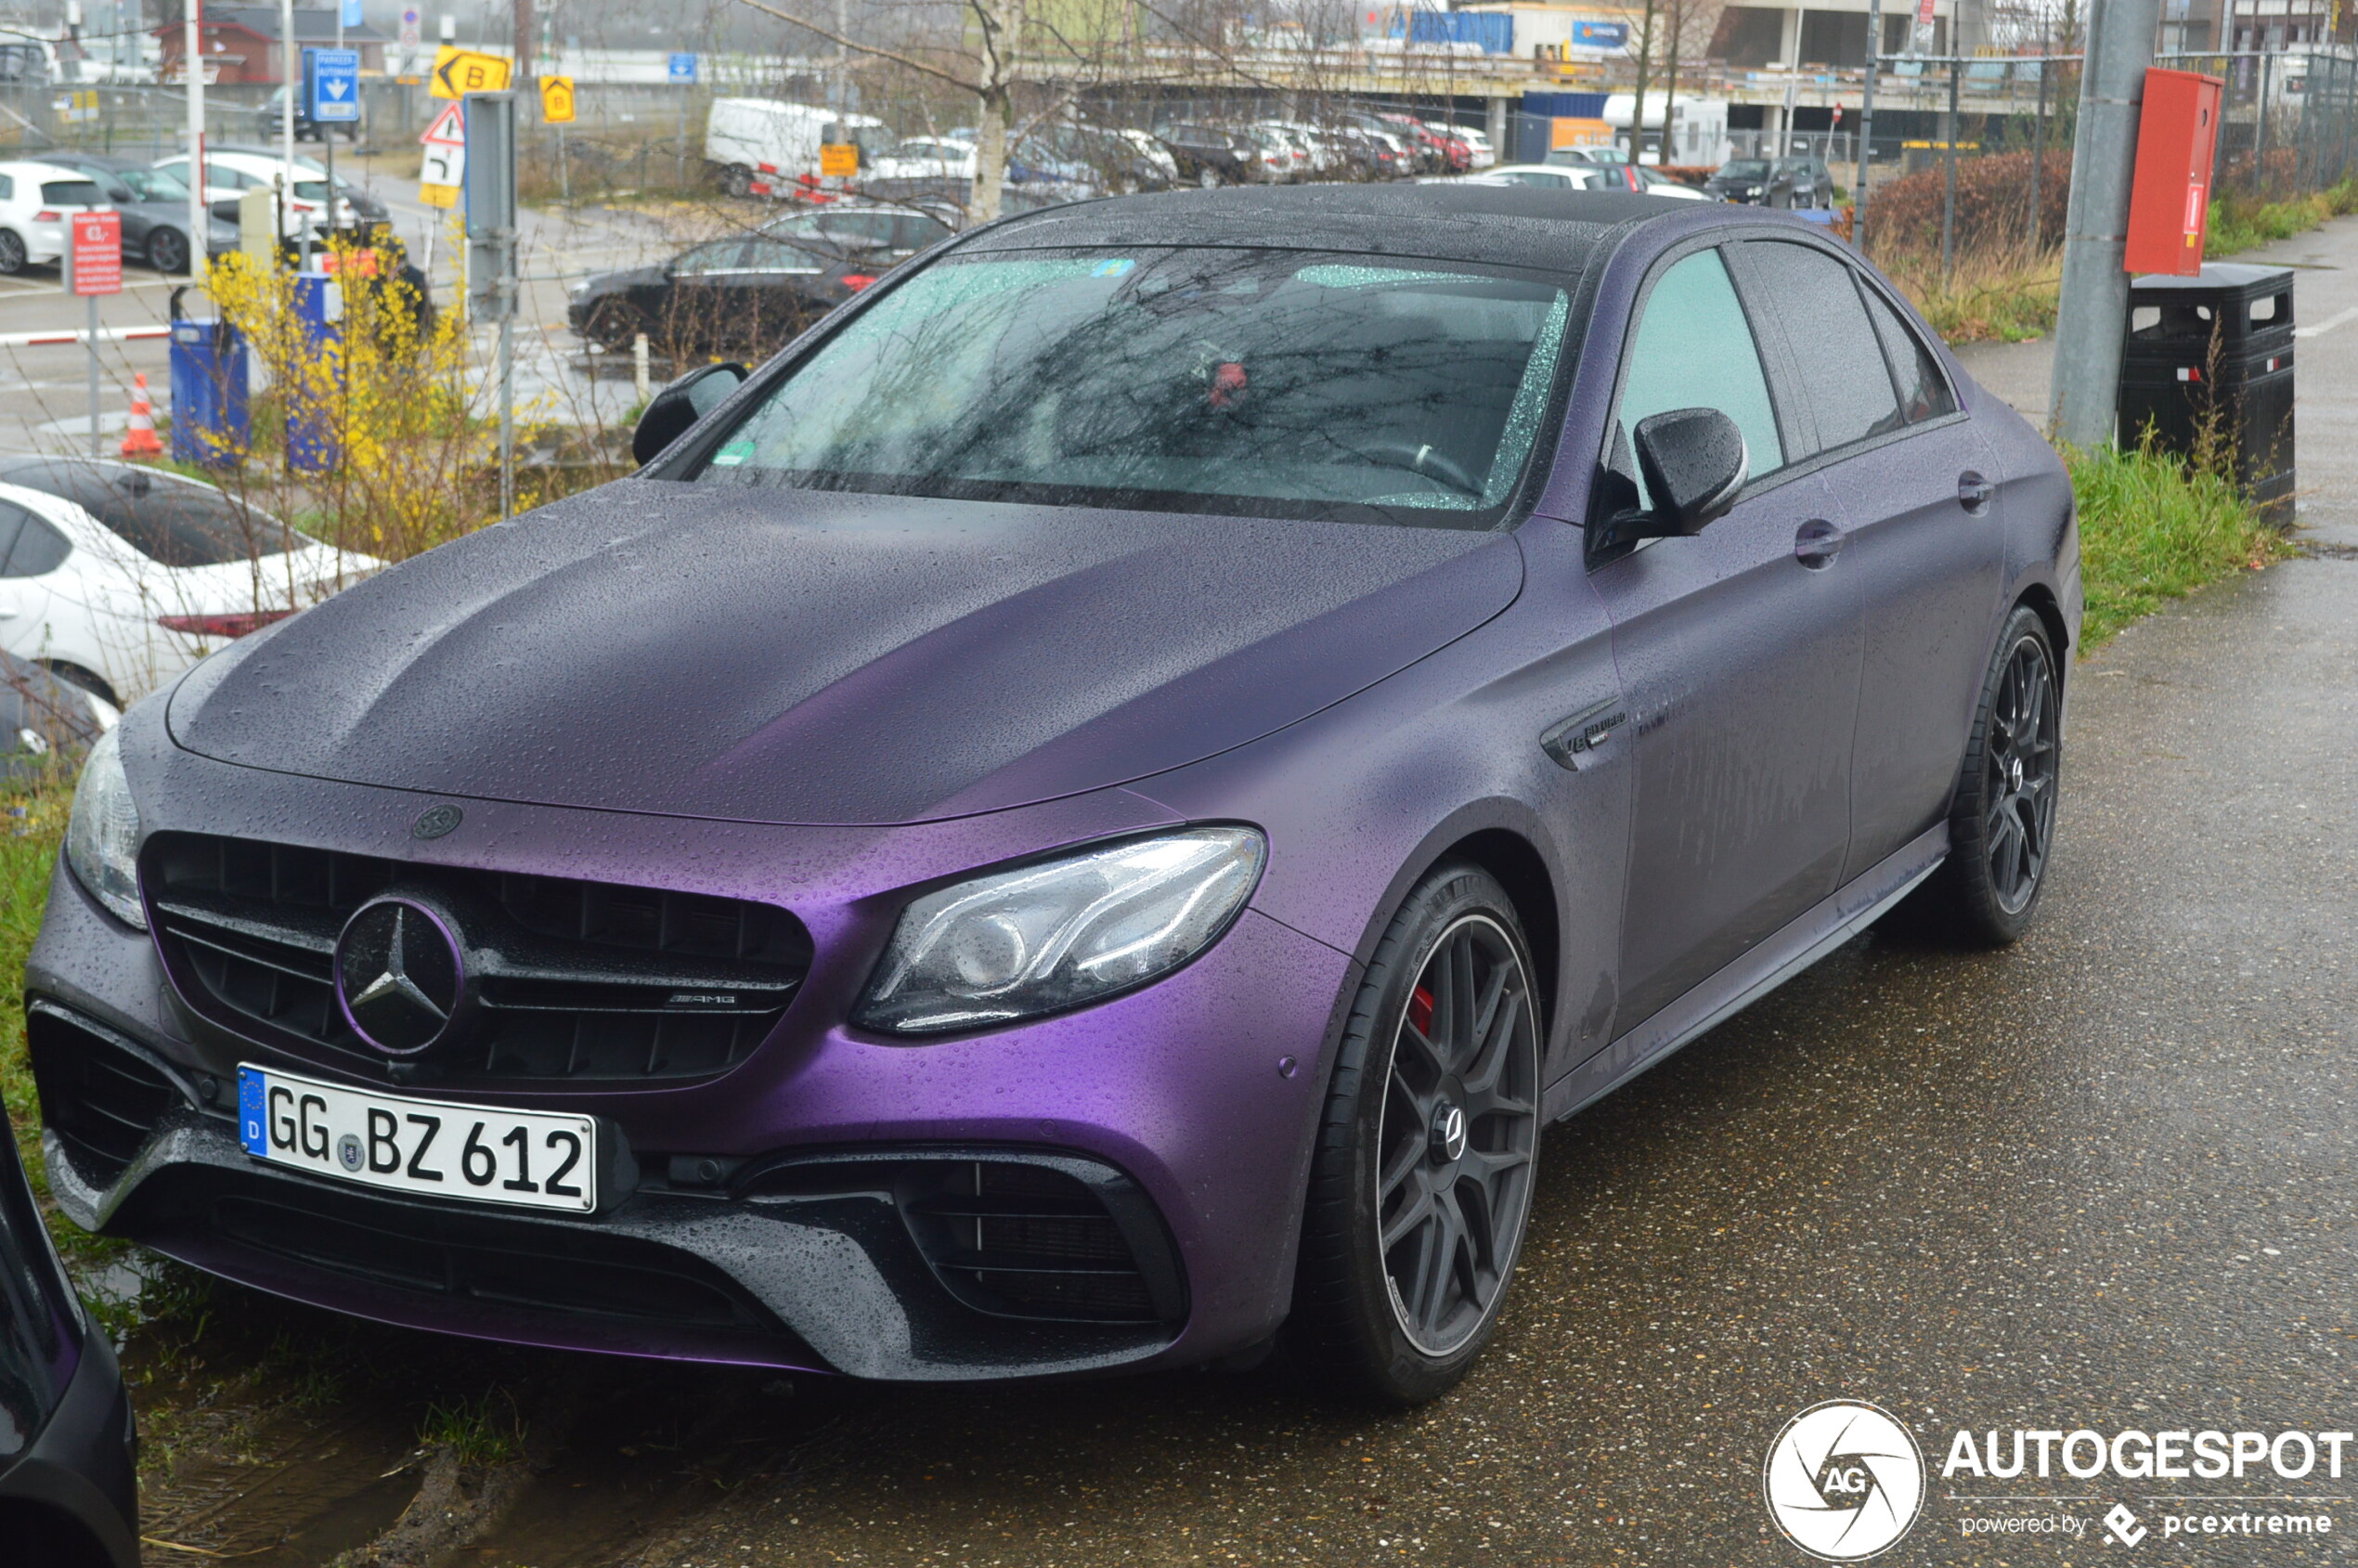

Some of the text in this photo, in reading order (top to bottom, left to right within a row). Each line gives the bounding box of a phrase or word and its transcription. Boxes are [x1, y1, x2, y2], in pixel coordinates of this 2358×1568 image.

[466, 66, 485, 88] B
[553, 96, 565, 110] B
[689, 995, 735, 1004] AMG
[247, 1120, 260, 1141] D
[268, 1085, 583, 1198] GG BZ 612
